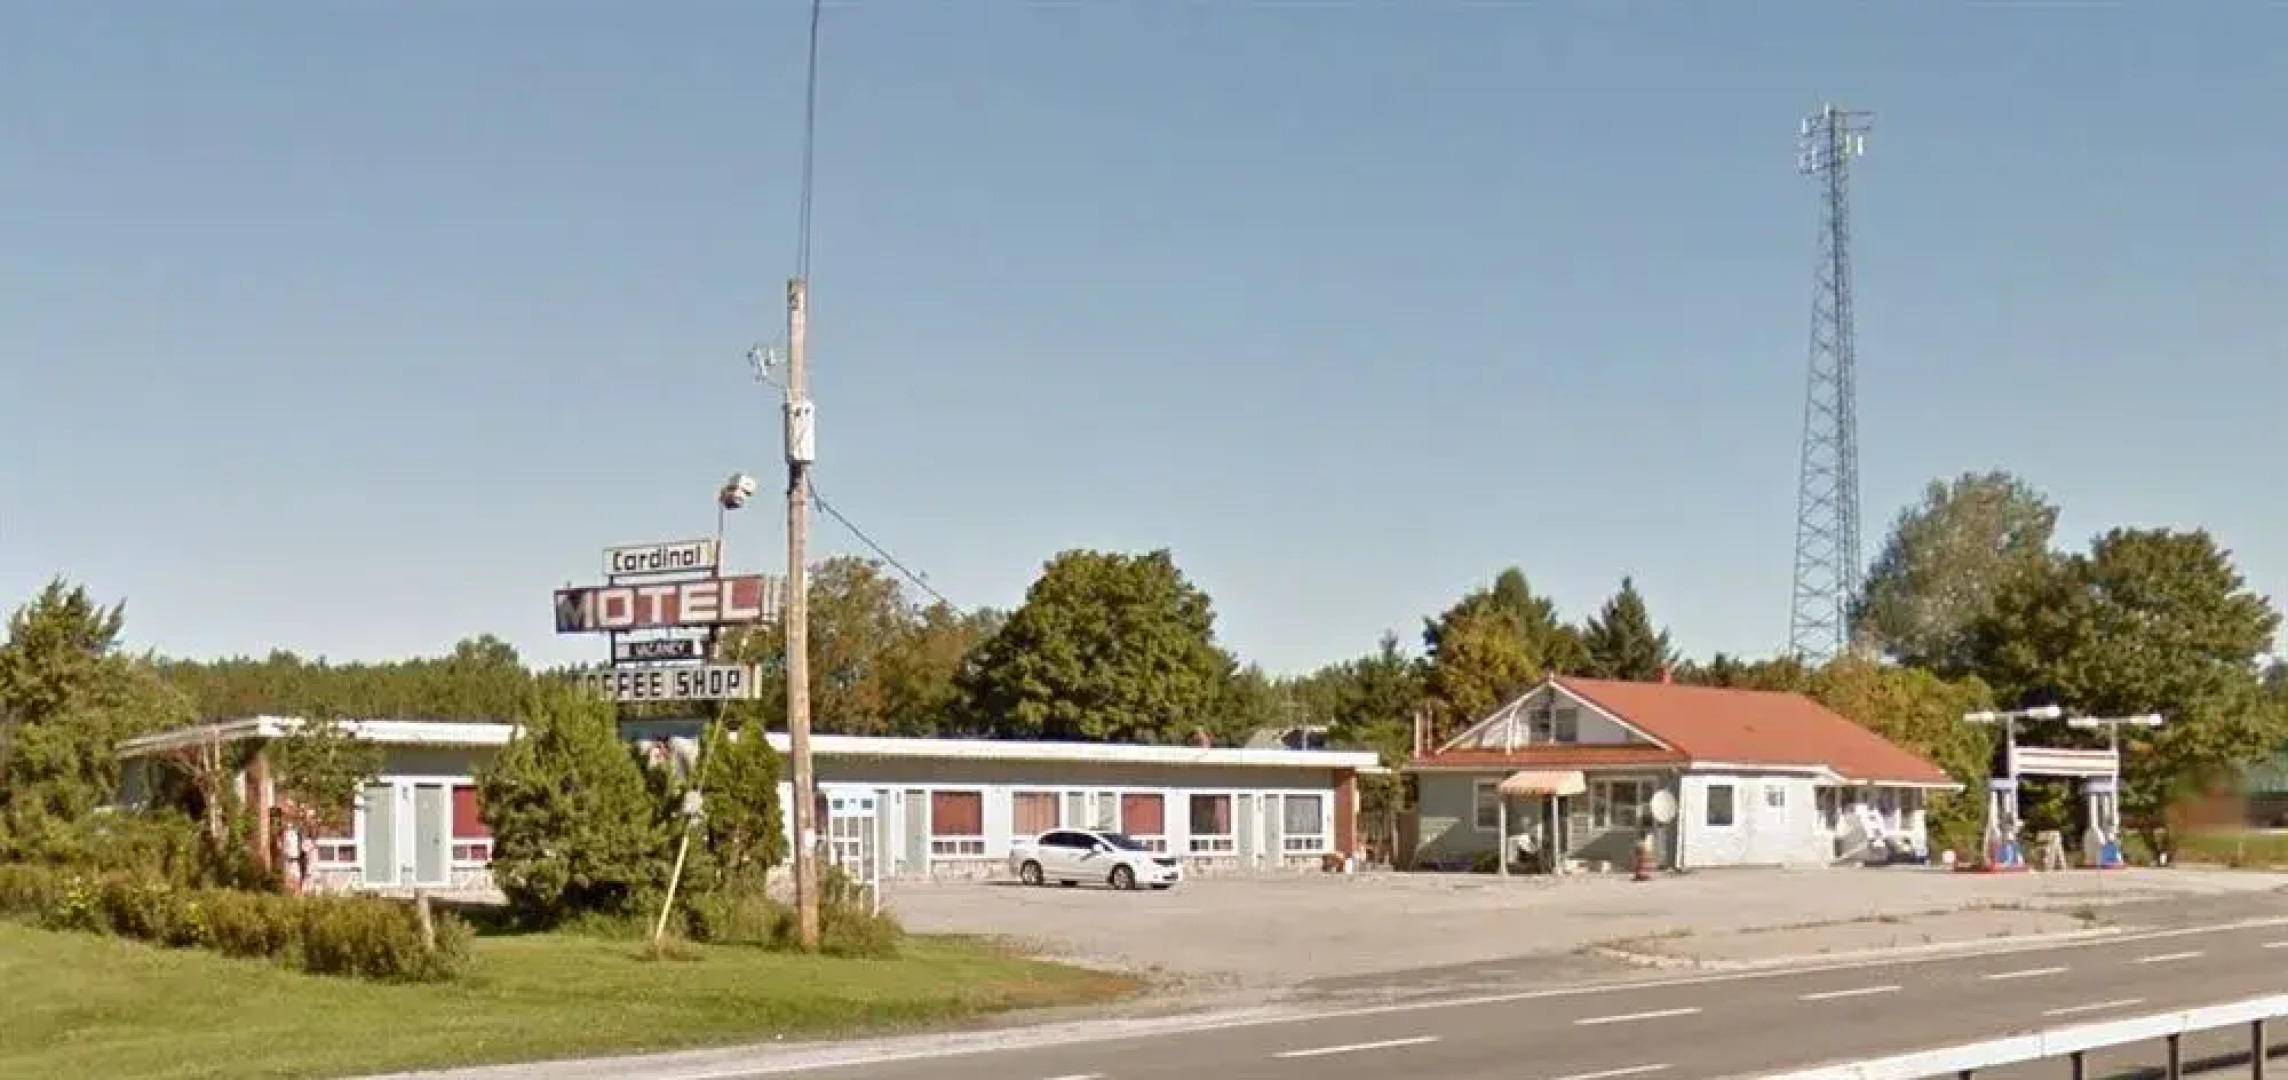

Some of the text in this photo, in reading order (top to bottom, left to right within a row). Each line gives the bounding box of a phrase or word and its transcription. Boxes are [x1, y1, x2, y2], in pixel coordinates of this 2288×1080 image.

[613, 546, 700, 571] Cardinal
[556, 580, 761, 631] MOTEL
[677, 670, 740, 696] SHOP
